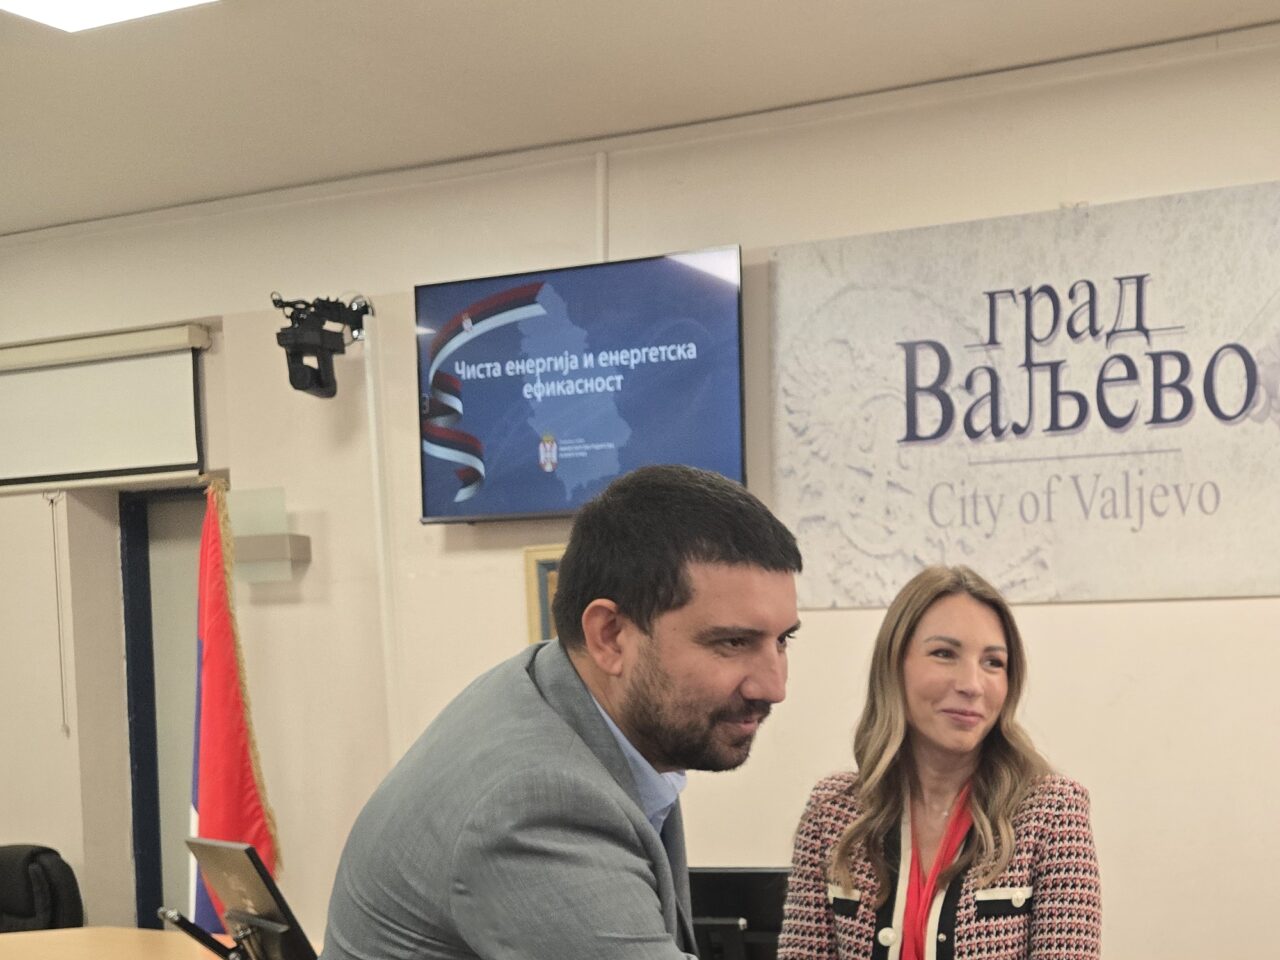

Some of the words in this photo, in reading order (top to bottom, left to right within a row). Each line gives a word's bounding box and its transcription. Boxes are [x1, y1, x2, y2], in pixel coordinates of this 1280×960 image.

[980, 273, 1153, 367] град
[454, 360, 502, 381] Чиста
[505, 350, 579, 376] енергија
[583, 351, 594, 369] и
[598, 342, 697, 370] енергетска
[522, 374, 624, 402] ефикасност
[895, 339, 1260, 444] Ваљево
[927, 480, 1005, 538] City
[1018, 473, 1063, 526] of
[1070, 468, 1222, 533] Valjevo
